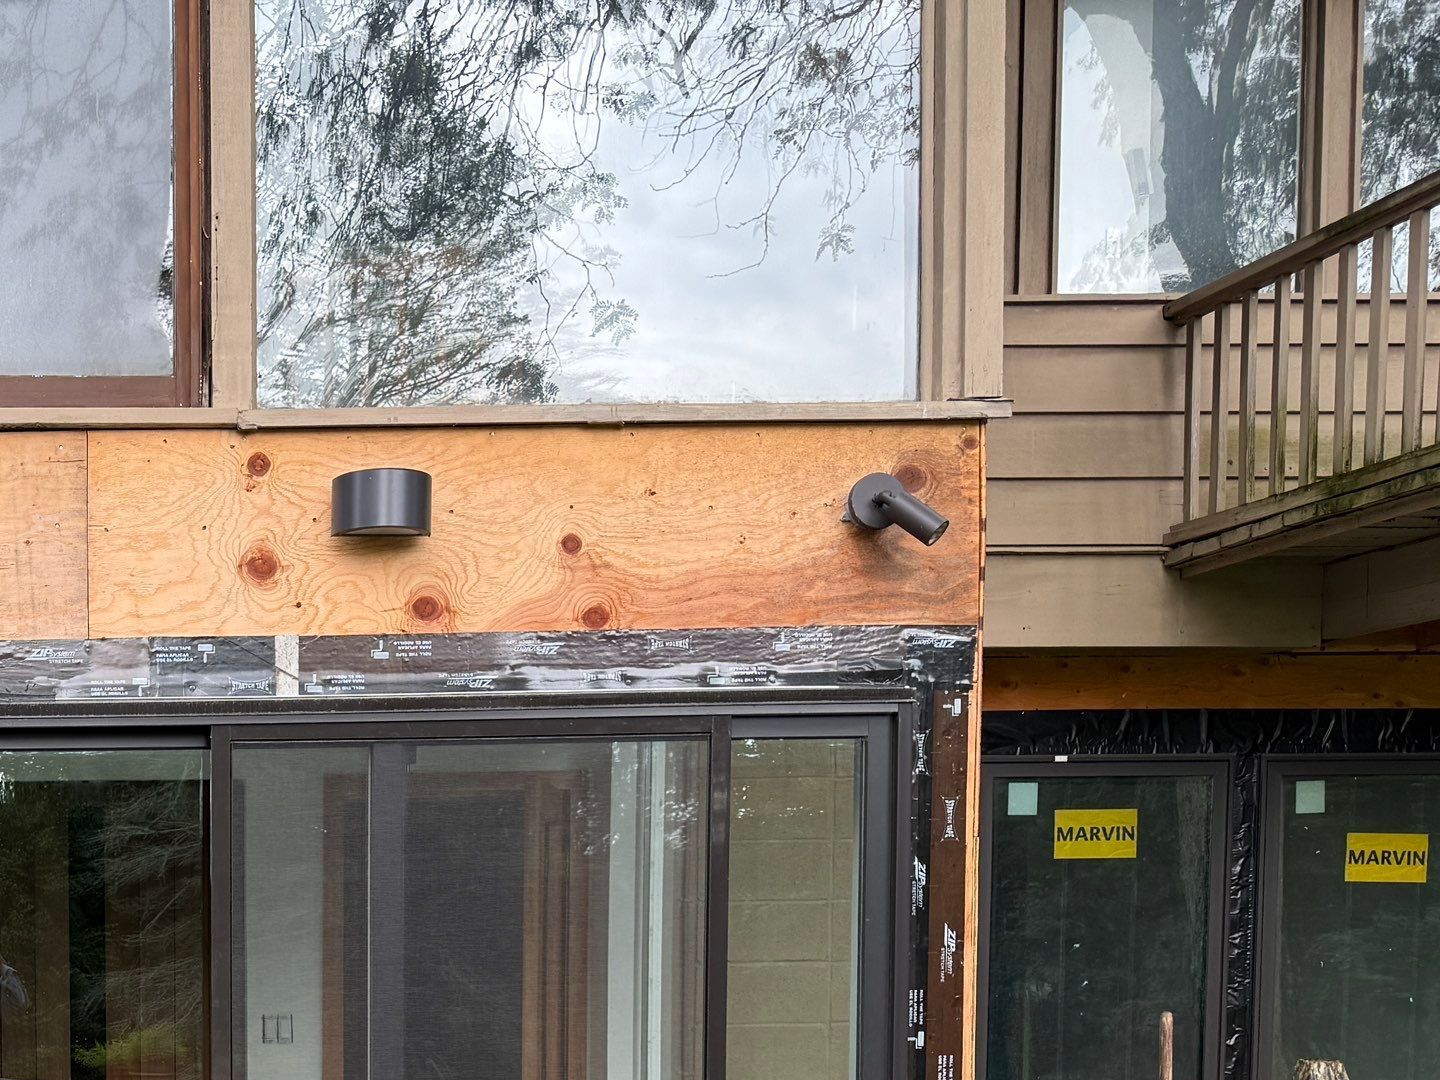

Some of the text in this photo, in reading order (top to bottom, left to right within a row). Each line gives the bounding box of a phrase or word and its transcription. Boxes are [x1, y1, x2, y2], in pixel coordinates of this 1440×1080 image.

[945, 824, 954, 837] TAPE
[1057, 826, 1134, 841] MARVIN
[1348, 850, 1425, 865] MARVIN
